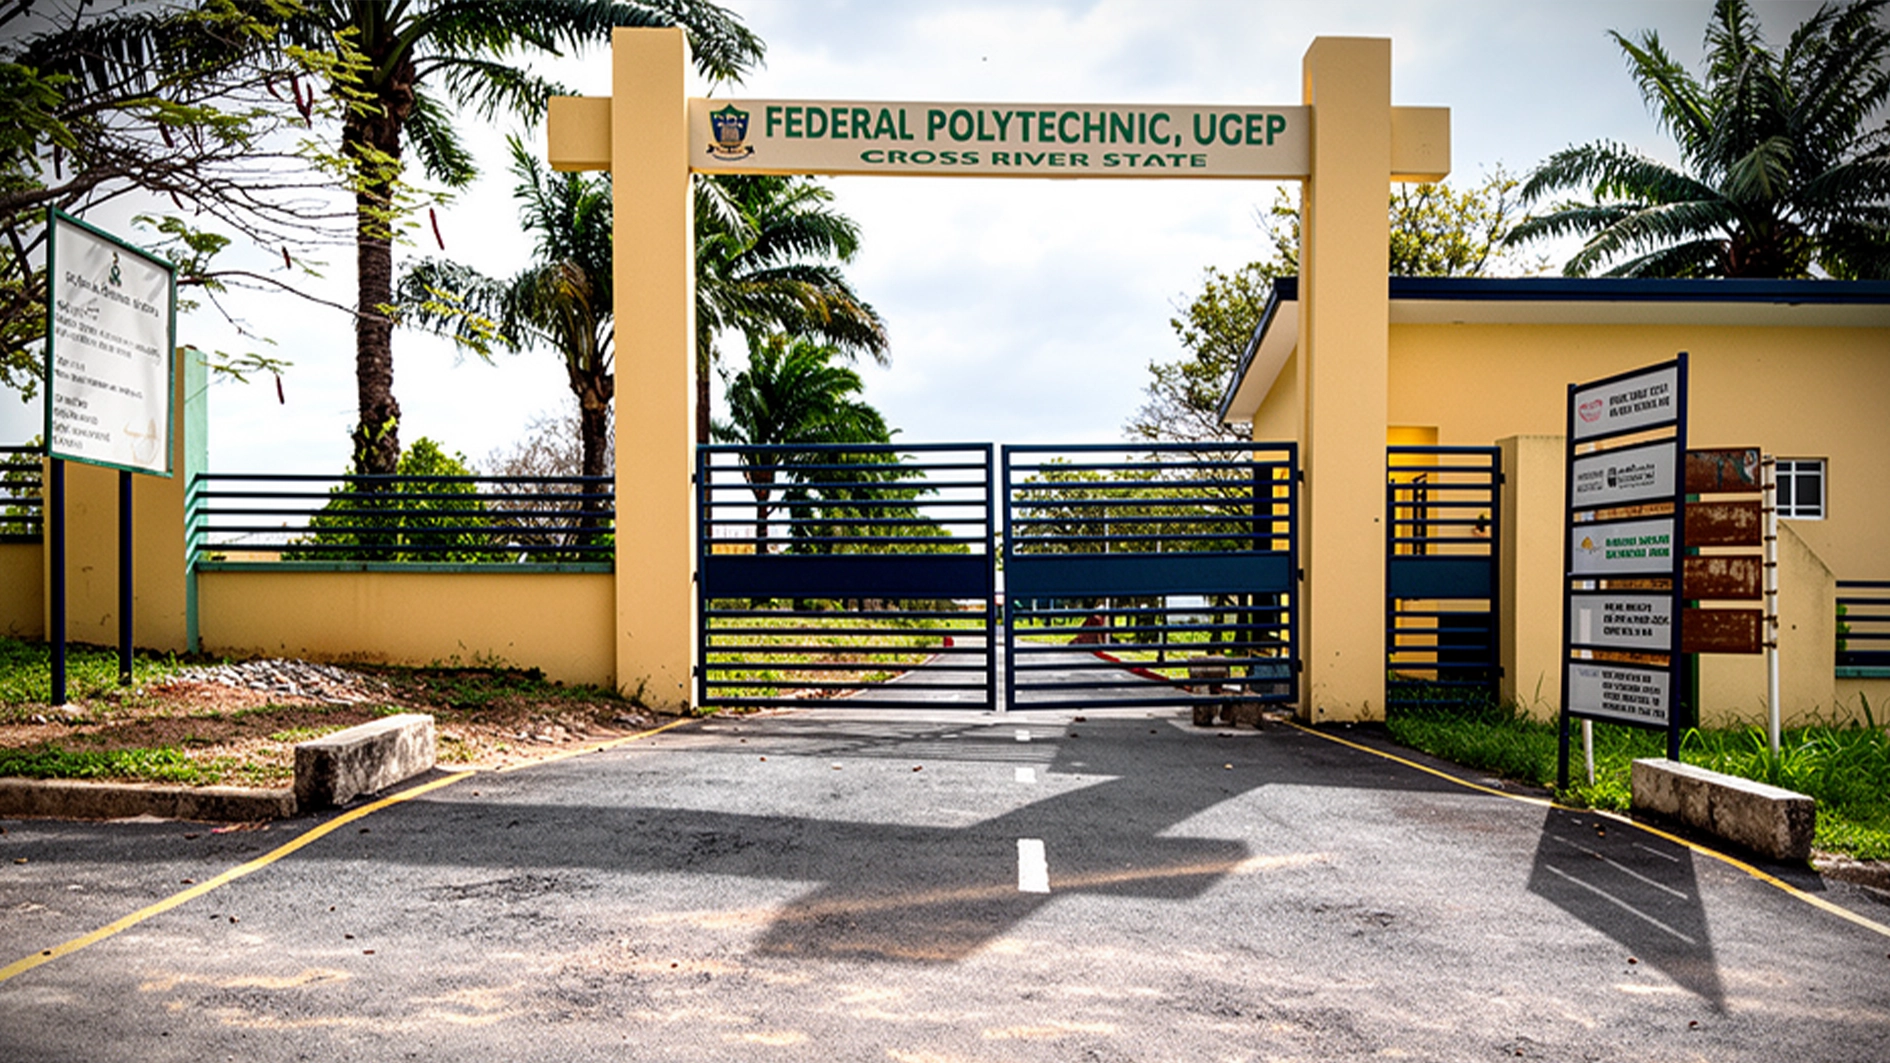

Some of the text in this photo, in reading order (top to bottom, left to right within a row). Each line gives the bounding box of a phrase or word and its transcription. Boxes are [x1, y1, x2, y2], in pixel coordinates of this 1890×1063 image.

[765, 105, 1288, 149] FEDERAL POLYTECHNIC, UGEP
[859, 149, 1208, 168] CROSS RIVER STATE
